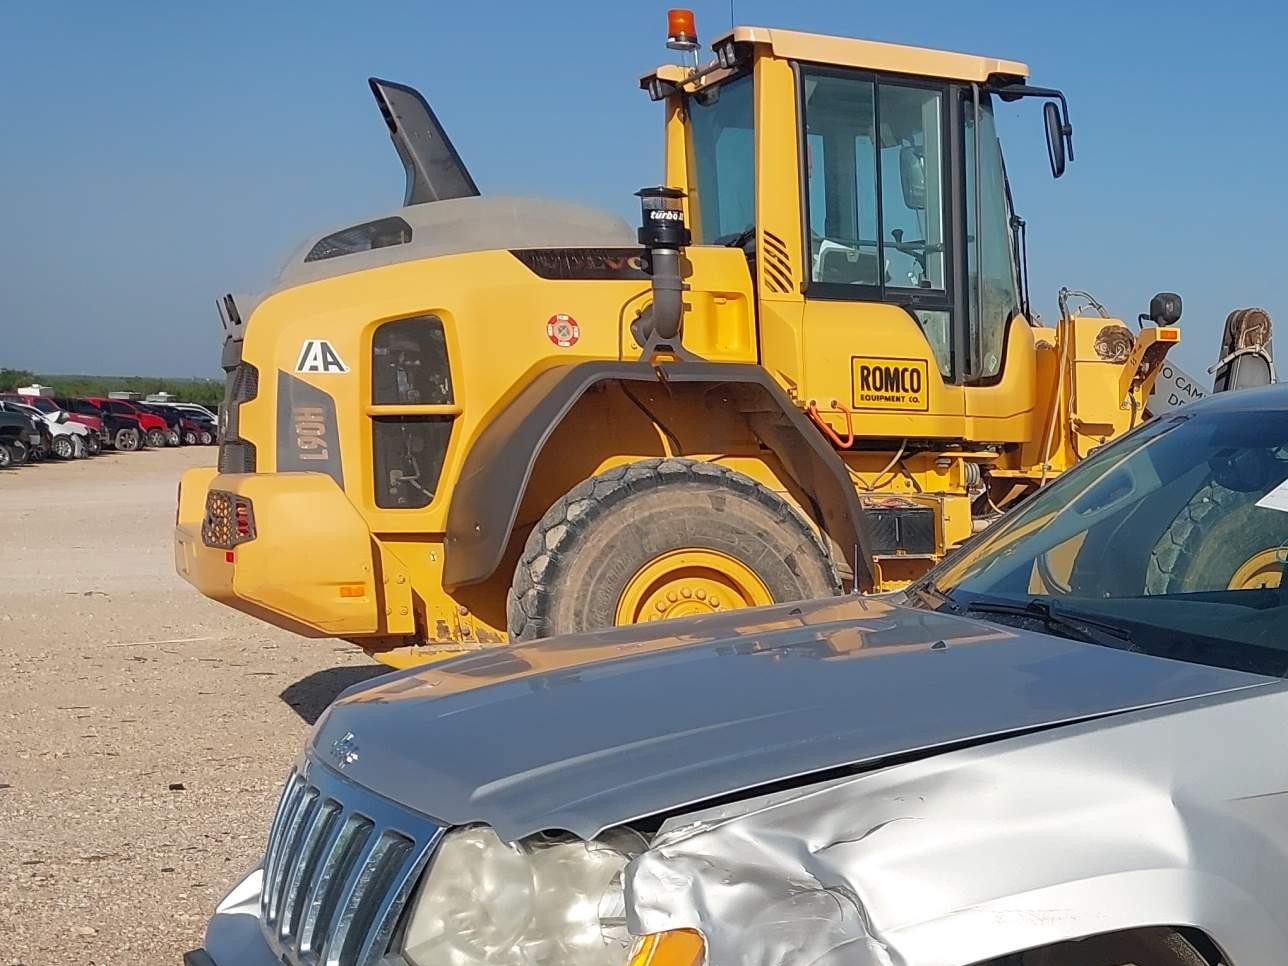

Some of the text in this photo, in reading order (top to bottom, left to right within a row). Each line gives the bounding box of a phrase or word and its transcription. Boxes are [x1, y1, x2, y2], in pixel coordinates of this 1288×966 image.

[297, 341, 346, 372] IAA
[860, 365, 921, 389] ROMCO
[860, 394, 921, 404] EQUIPMENT CO.
